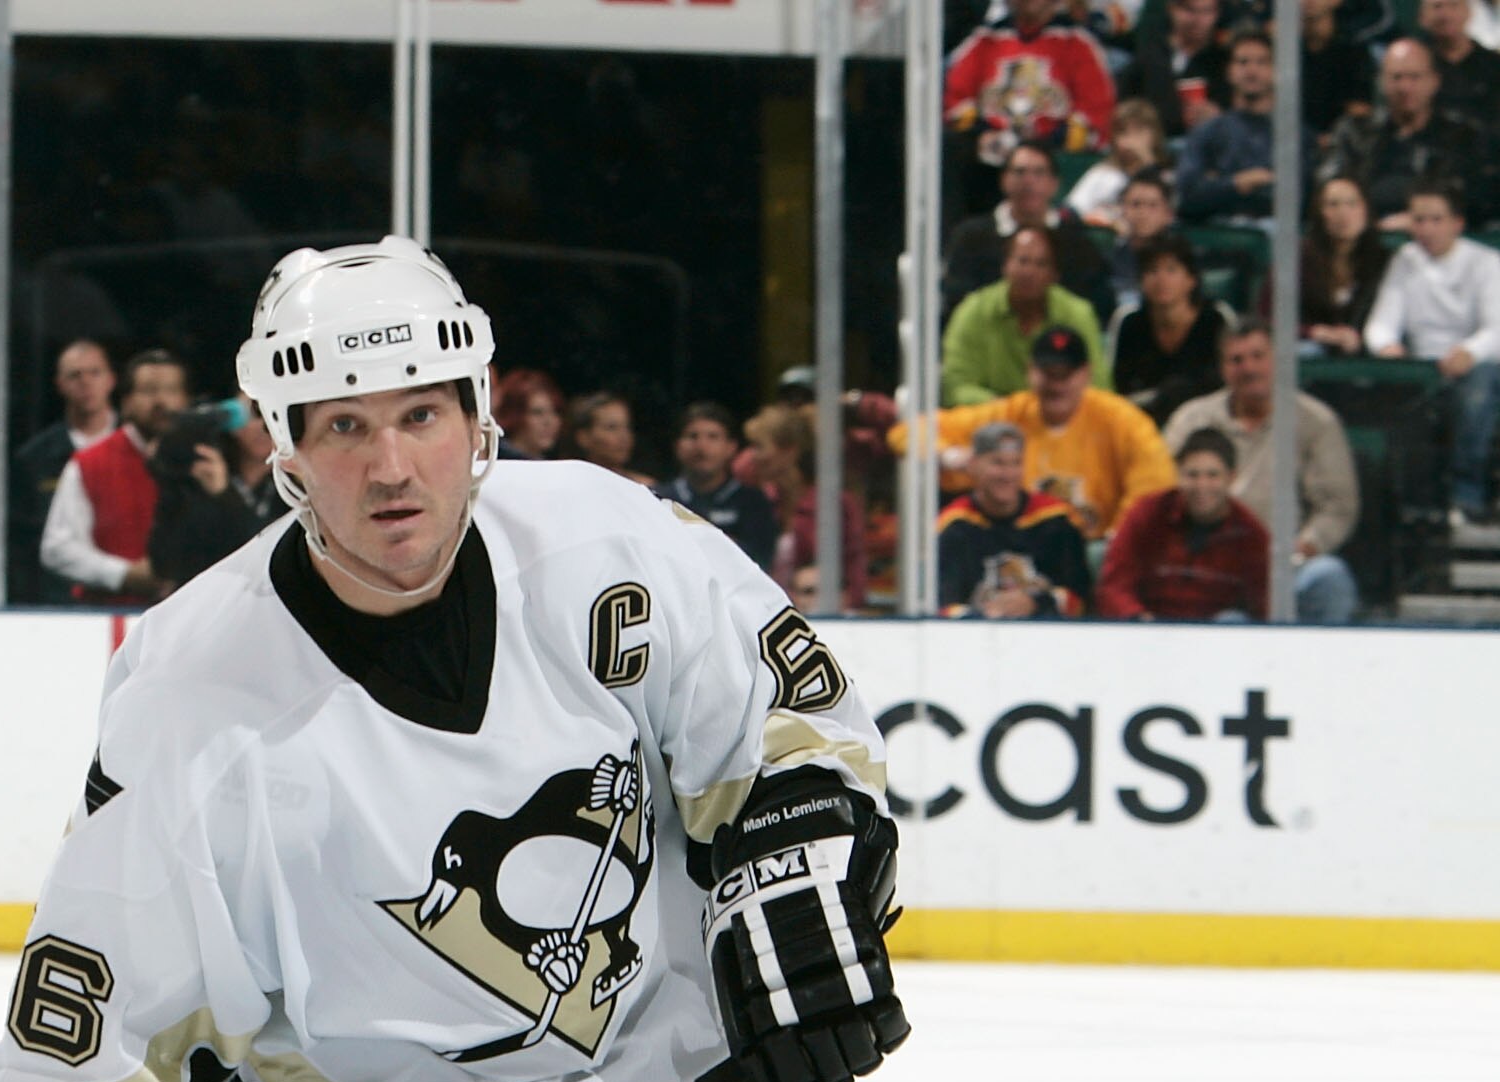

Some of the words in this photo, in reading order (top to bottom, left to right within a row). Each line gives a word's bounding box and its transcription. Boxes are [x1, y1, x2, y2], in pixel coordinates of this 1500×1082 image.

[343, 324, 411, 349] CCM
[589, 582, 651, 688] C
[758, 605, 847, 713] 6
[743, 812, 781, 834] Mario
[783, 796, 842, 821] Lemieux
[8, 934, 115, 1067] 6
